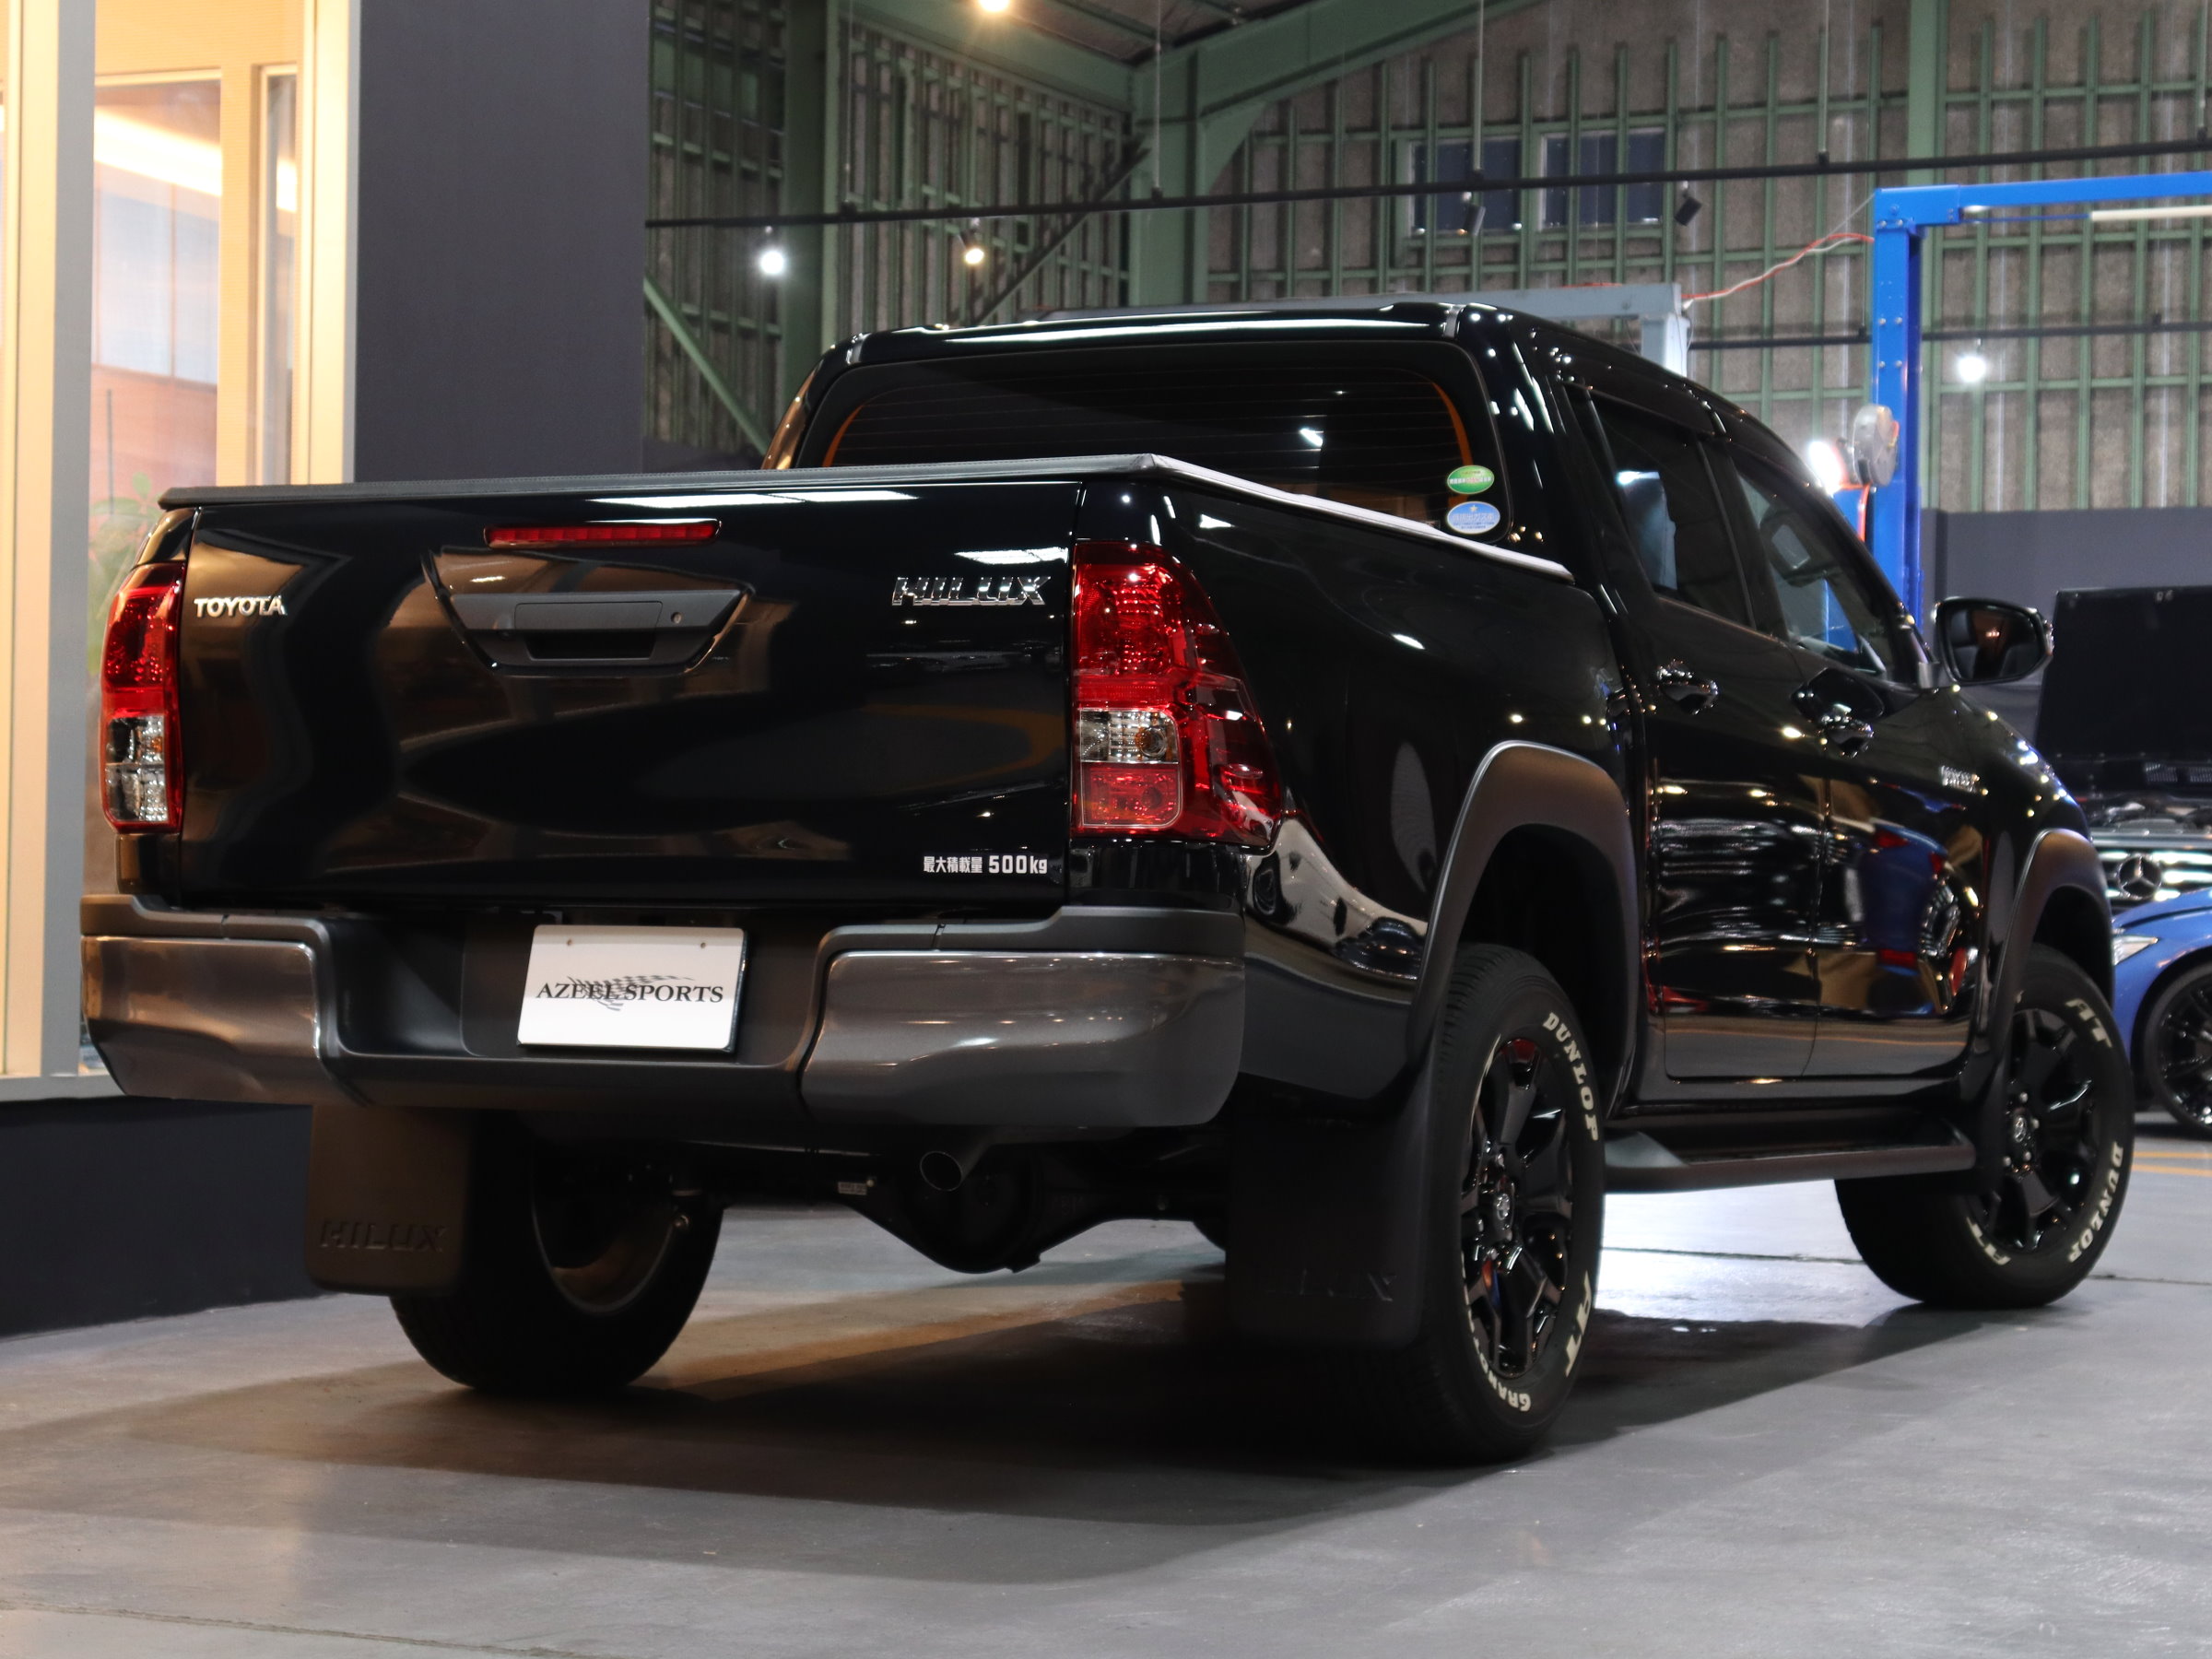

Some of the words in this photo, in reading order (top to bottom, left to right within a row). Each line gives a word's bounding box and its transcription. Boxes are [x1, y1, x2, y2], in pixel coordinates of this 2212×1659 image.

[194, 594, 288, 618] TOYOTA
[891, 576, 1052, 606] HILUX
[924, 855, 982, 874] 最大積載量
[989, 854, 1047, 874] 500kg
[624, 983, 724, 1003] SPORTS
[1542, 1012, 1599, 1141] DUNLOP
[2067, 1141, 2124, 1264] DUNLOP
[320, 1220, 448, 1253] HILUX
